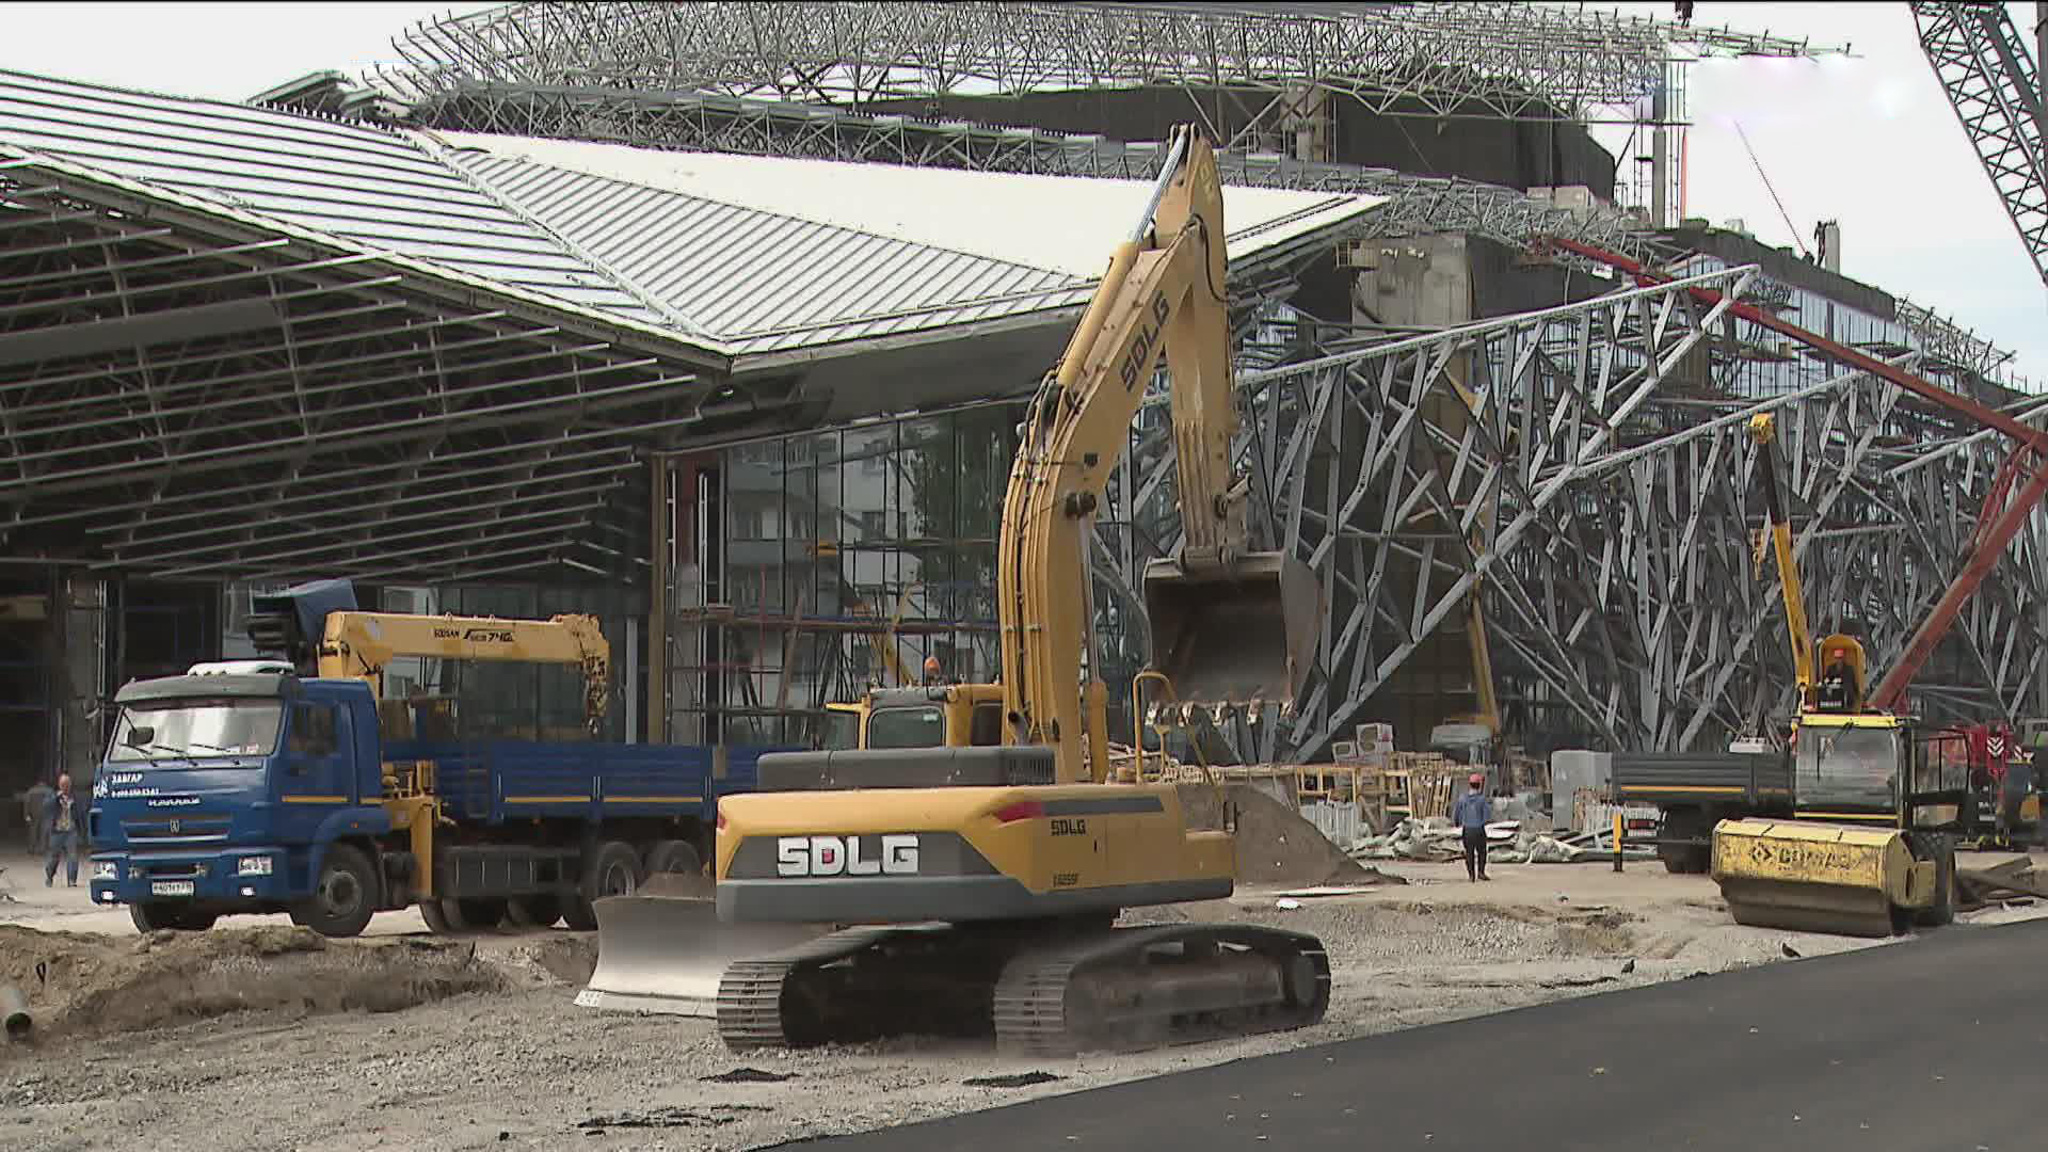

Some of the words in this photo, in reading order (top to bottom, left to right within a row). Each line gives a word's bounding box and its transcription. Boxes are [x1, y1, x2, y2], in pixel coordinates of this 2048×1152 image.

[1120, 290, 1170, 393] SDLG
[1051, 819, 1086, 836] SDLG
[778, 836, 919, 875] SDLG
